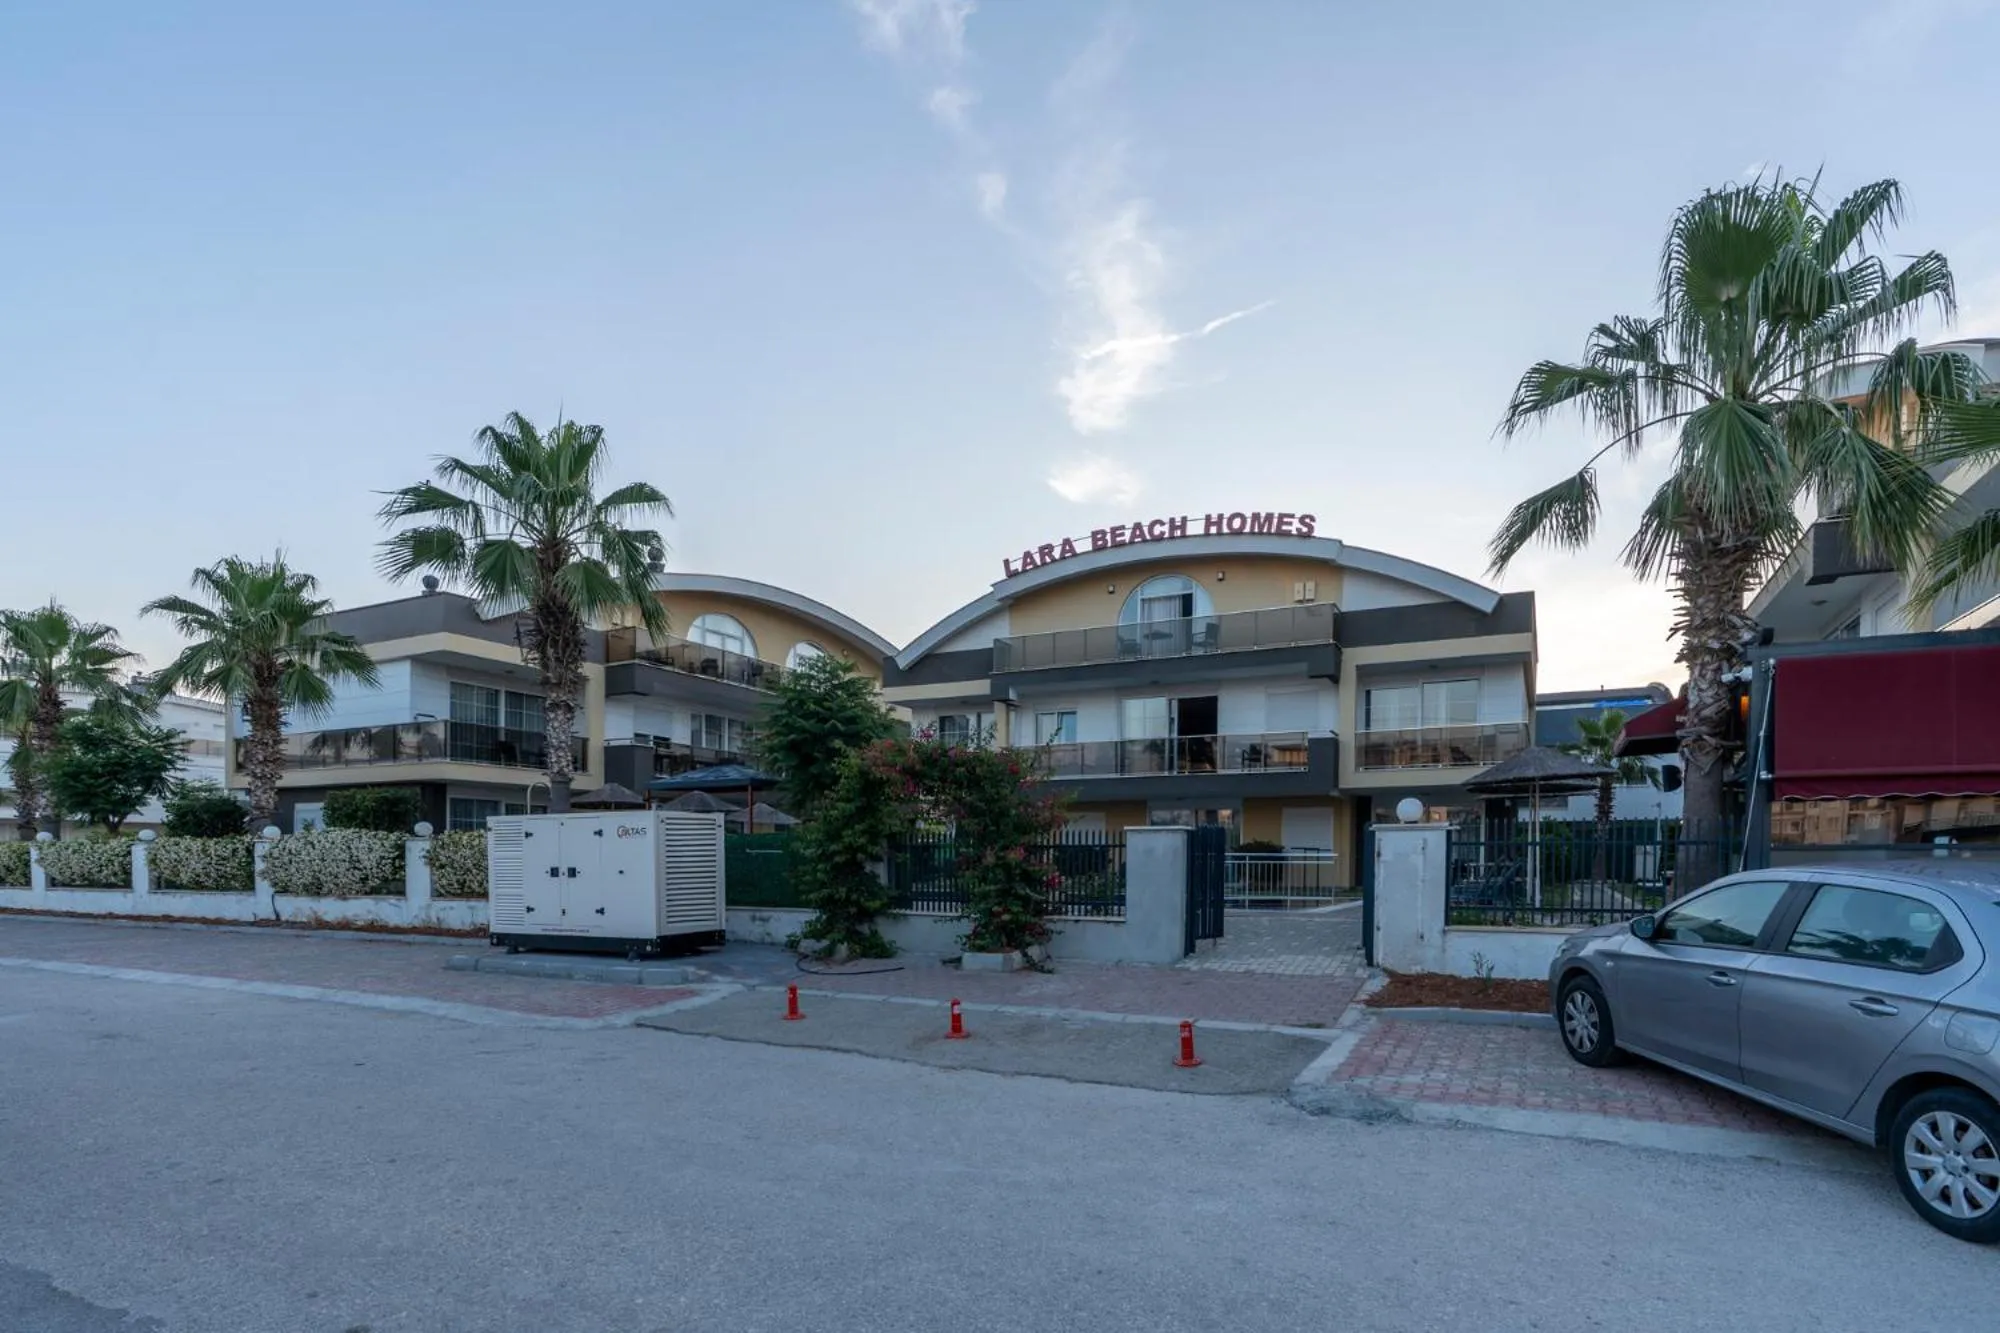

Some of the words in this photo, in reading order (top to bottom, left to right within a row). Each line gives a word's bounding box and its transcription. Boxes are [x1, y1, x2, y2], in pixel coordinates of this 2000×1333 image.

[1003, 537, 1078, 578] LARA
[1091, 516, 1188, 550] BEACH
[1204, 512, 1316, 537] HOMES
